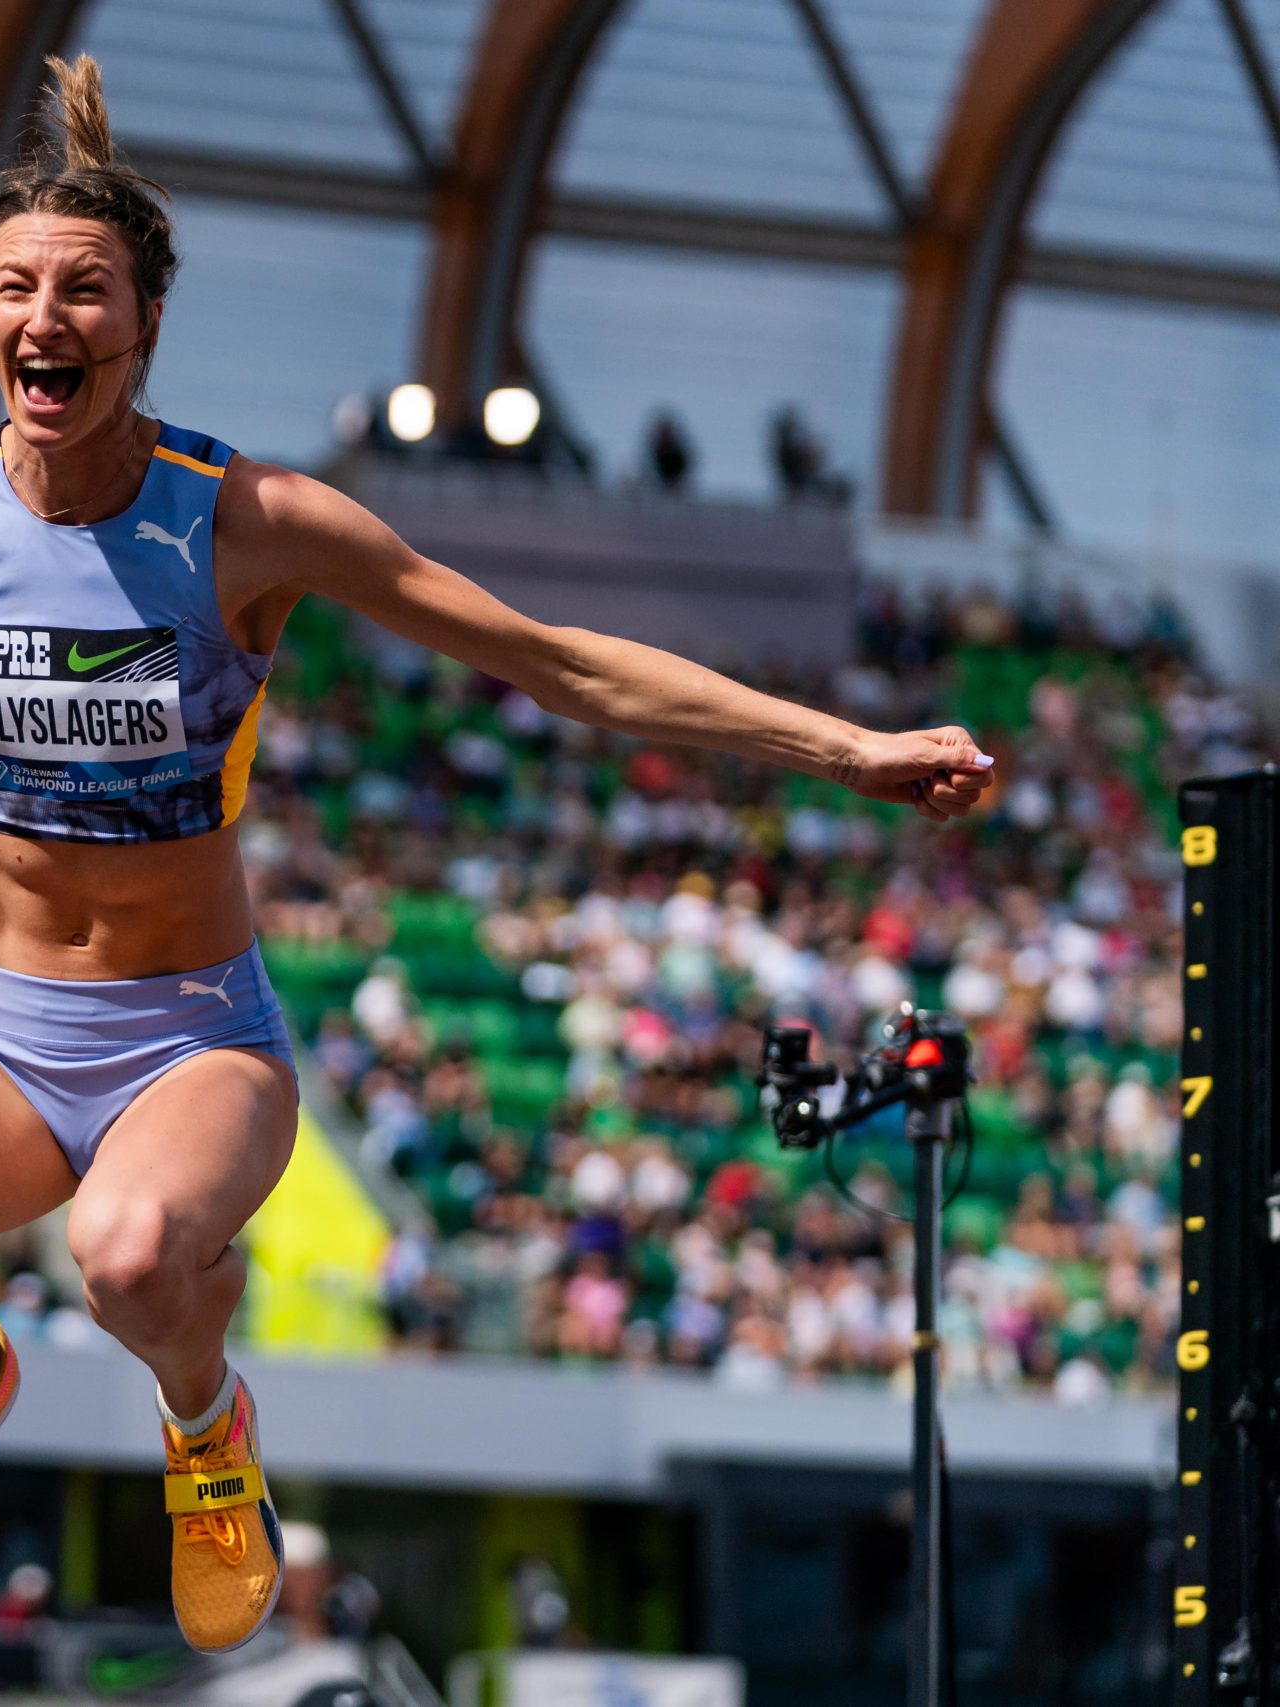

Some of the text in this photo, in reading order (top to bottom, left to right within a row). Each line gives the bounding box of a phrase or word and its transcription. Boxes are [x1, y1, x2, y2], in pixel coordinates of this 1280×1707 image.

[13, 767, 184, 793] DIAMOND LEAGUE FINAL
[39, 769, 70, 779] WANDA
[1180, 825, 1218, 866] 8
[1179, 1076, 1214, 1119] 7
[1176, 1329, 1210, 1371] 6
[197, 1476, 245, 1501] PUMA
[1174, 1585, 1207, 1628] 5
